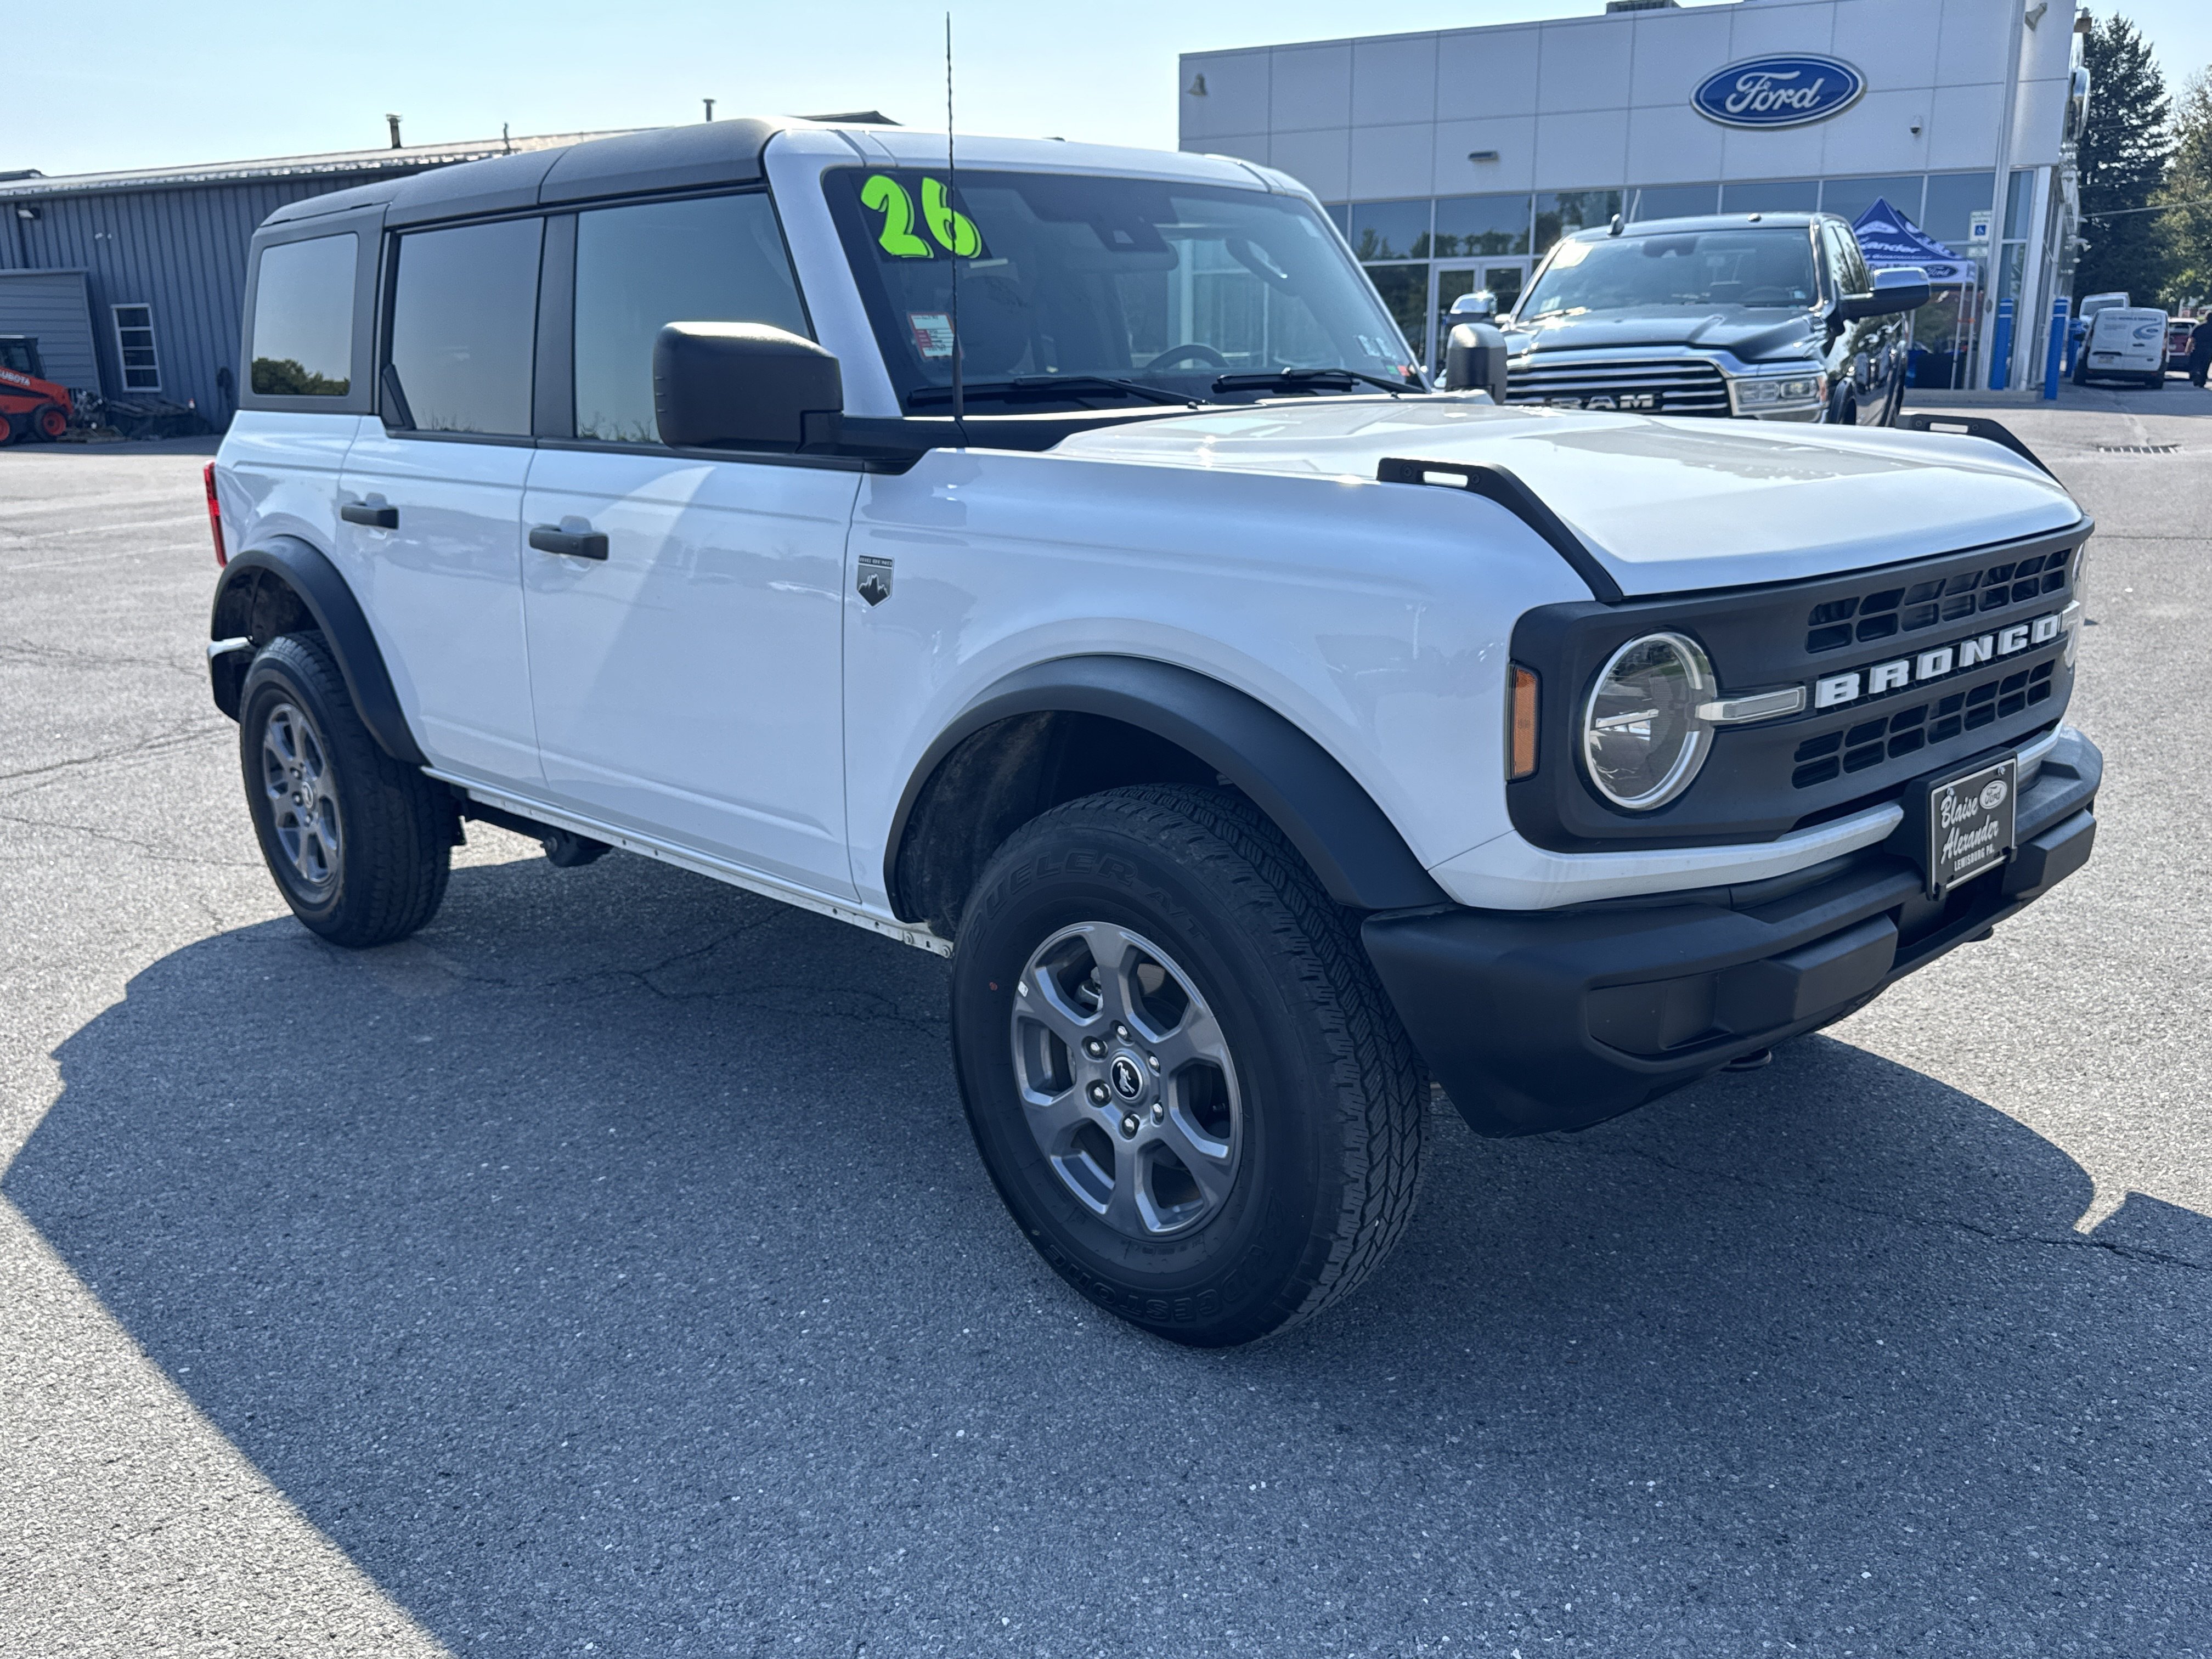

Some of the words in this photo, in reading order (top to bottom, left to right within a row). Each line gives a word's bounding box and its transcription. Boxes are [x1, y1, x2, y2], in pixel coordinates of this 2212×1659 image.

[1725, 70, 1825, 114] Ford
[861, 174, 982, 258] 26
[0, 369, 31, 387] UBOTA
[1551, 394, 1654, 410] RAM
[1815, 614, 2059, 709] BRONCO
[1940, 795, 1979, 829] Blaise
[1984, 785, 2003, 805] Ford
[1940, 814, 1999, 865] Alexander
[1954, 847, 1985, 872] LEWISBURG
[1985, 843, 1995, 857] PA.
[967, 848, 1138, 959] DUELER
[1144, 887, 1211, 940] A/T
